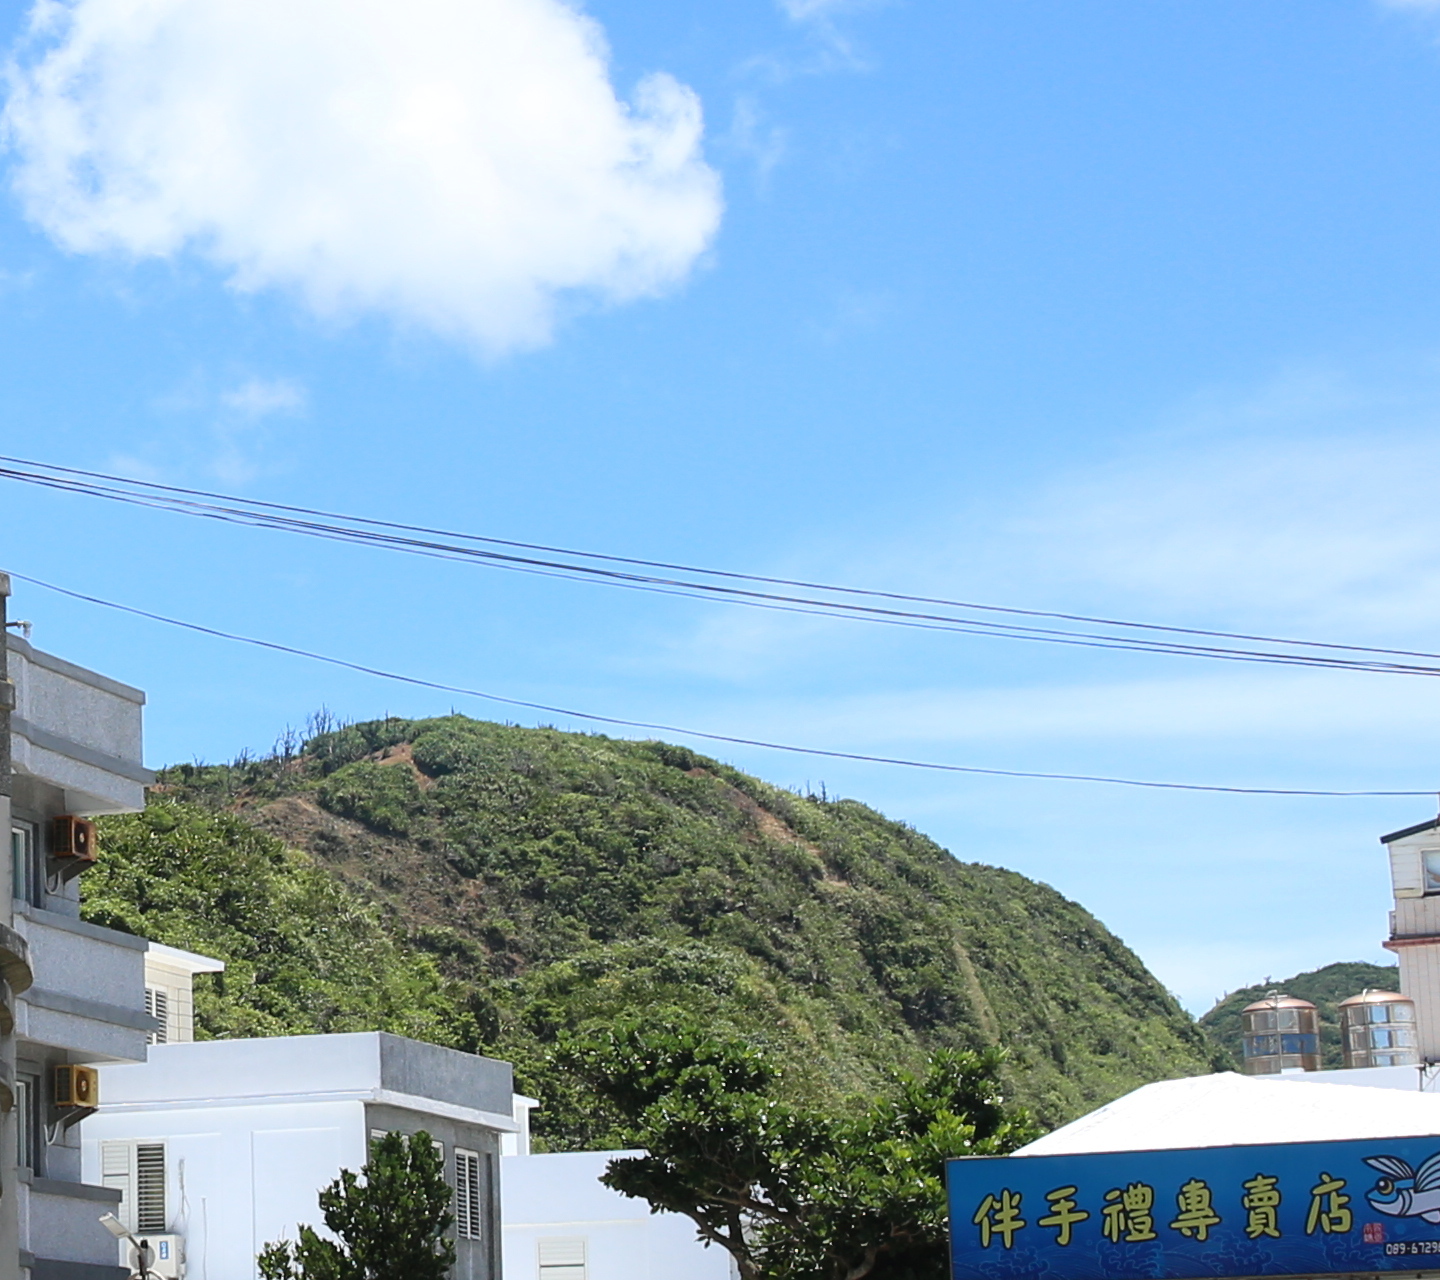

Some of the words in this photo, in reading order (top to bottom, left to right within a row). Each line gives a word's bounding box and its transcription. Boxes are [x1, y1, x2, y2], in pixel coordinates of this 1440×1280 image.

[973, 1172, 1354, 1248] 伴手禮專賣店
